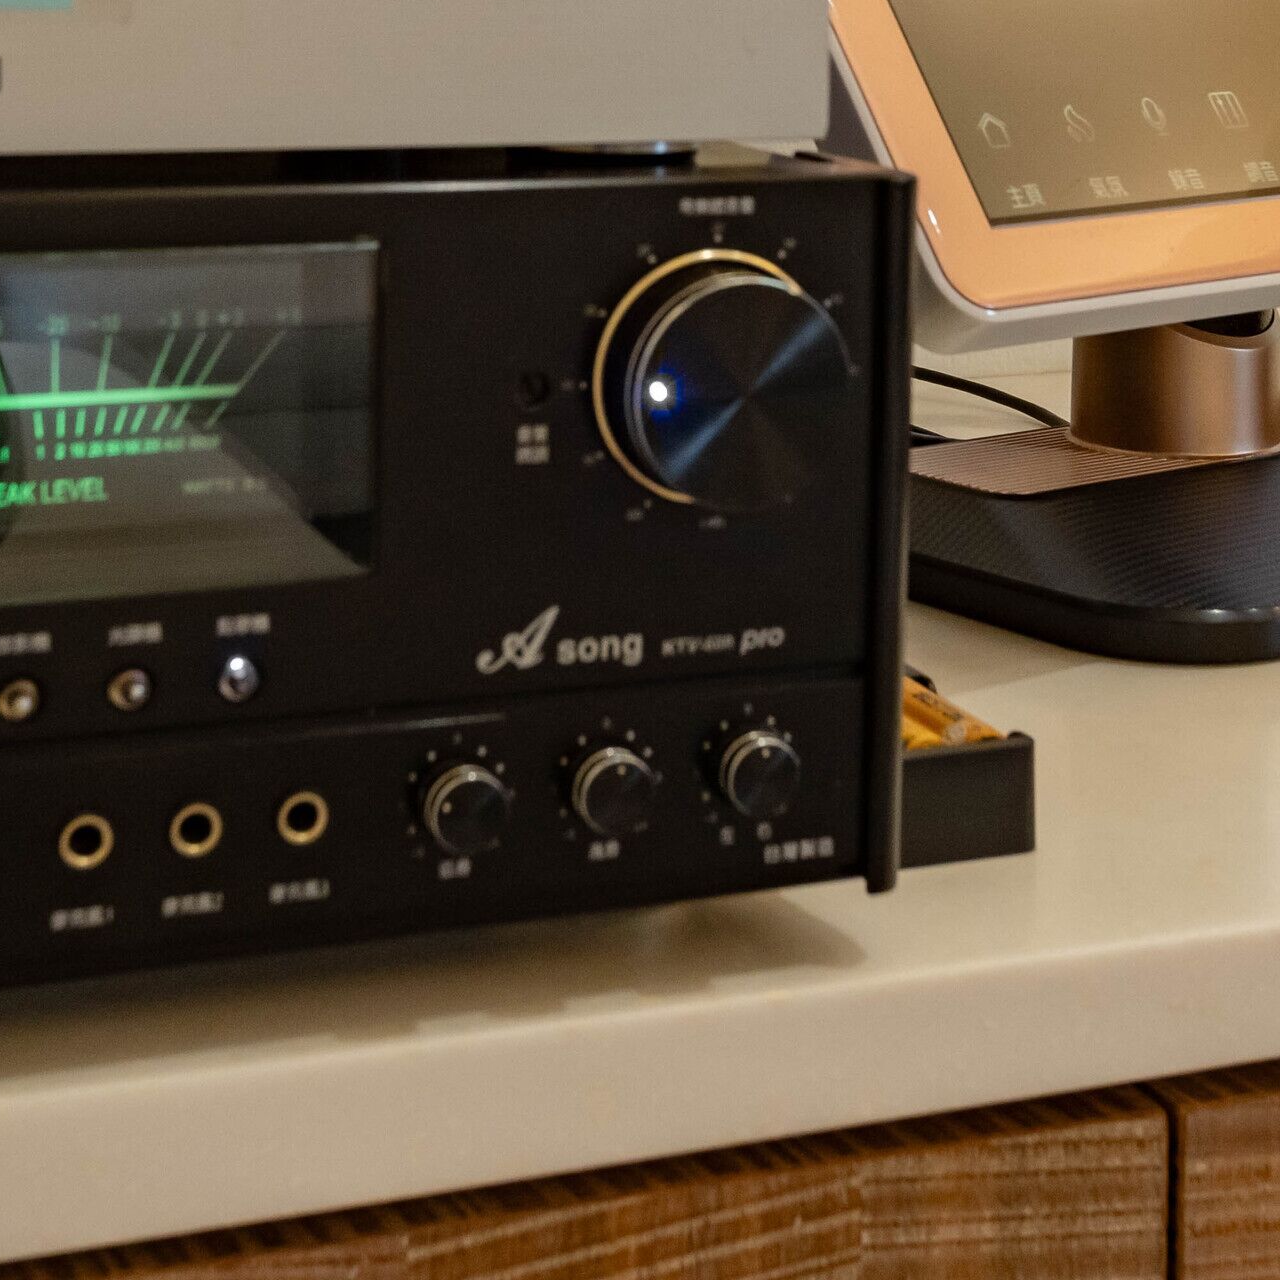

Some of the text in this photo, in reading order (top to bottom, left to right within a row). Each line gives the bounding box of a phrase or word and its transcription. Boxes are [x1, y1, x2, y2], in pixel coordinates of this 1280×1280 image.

[1004, 182, 1047, 210] 主頁
[39, 475, 108, 507] LEVEL
[557, 632, 644, 667] song
[740, 626, 786, 657] pro
